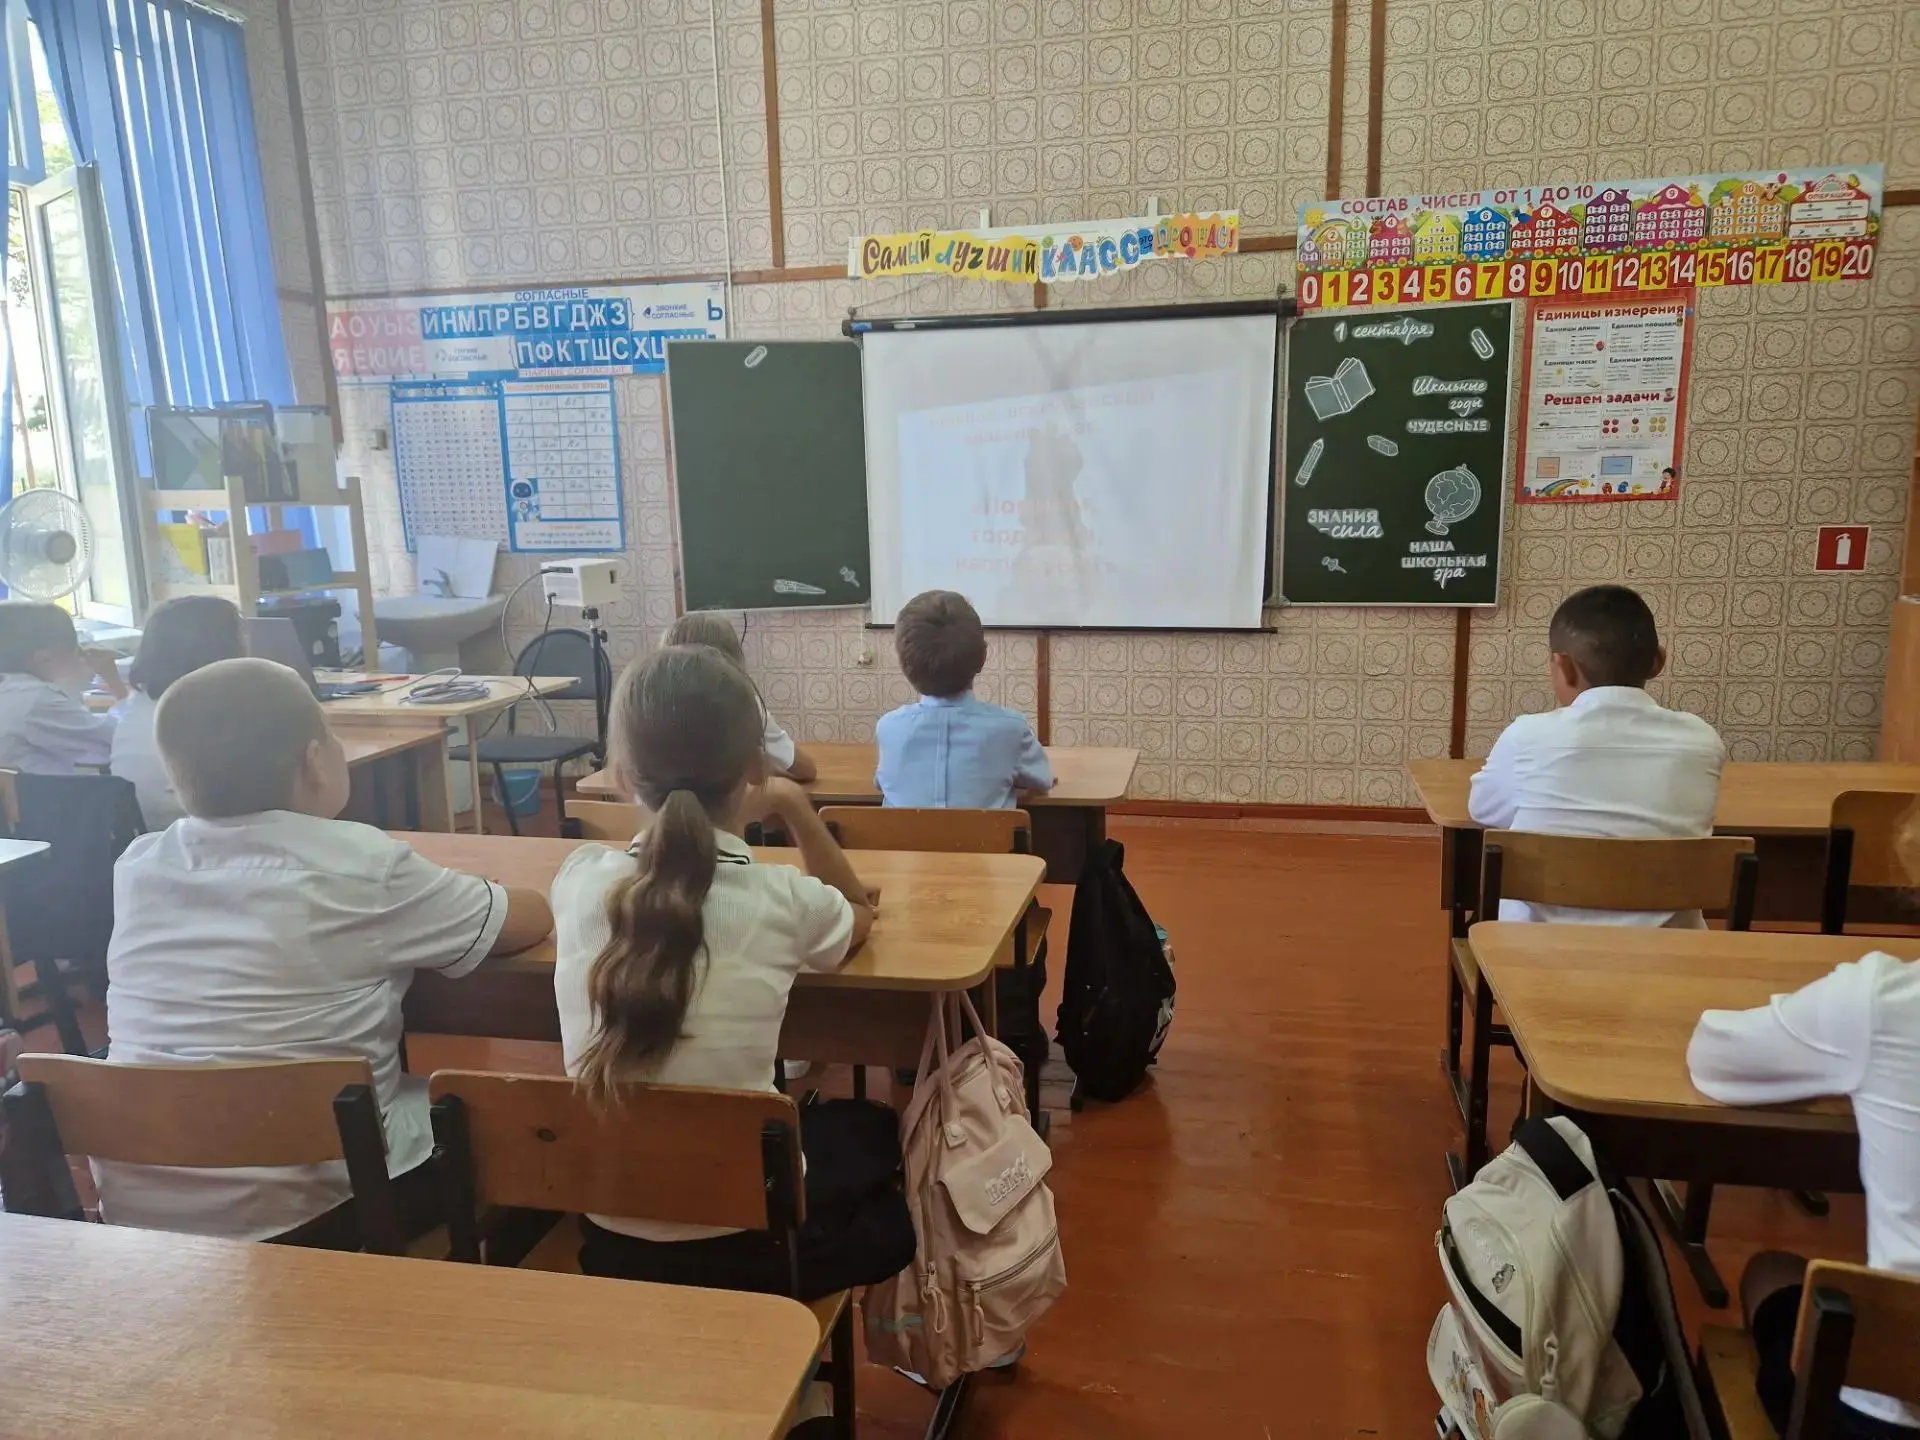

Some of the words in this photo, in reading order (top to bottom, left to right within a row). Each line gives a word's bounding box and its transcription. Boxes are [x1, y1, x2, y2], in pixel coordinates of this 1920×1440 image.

[1340, 199, 1408, 214] СОСТАВ
[1421, 193, 1480, 208] ЧИСЕЛ
[1494, 190, 1518, 204] ОТ
[1524, 190, 1530, 202] 1
[1540, 187, 1570, 204] ДО
[1574, 186, 1593, 199] 10
[863, 233, 931, 274] Самый
[1042, 233, 1139, 278] КЛАСС
[1328, 276, 1338, 303] 1
[1352, 274, 1369, 300] 2
[1378, 272, 1394, 300] 3
[1404, 270, 1420, 298] 4
[1430, 270, 1446, 297] 5
[1455, 268, 1472, 296] 6
[1482, 266, 1500, 294] 7
[1509, 264, 1525, 292] 8
[1535, 263, 1552, 292] 9
[1559, 261, 1583, 290] 10
[1586, 260, 1609, 286] 11
[1613, 258, 1639, 286] 12
[1641, 256, 1667, 284] 13
[1670, 254, 1696, 282] 14
[1699, 252, 1724, 282] 15
[1728, 251, 1753, 280] 16
[1756, 250, 1782, 279] 17
[1785, 249, 1810, 277] 18
[1815, 246, 1840, 276] 19
[1841, 244, 1872, 275] 20
[515, 288, 589, 302] СОГЛАСНЫЕ
[1536, 308, 1600, 322] Единицы
[1605, 305, 1684, 318] измерения
[1335, 322, 1345, 339] 1
[1413, 378, 1488, 394] Школьные
[1450, 397, 1482, 416] годы
[1544, 394, 1601, 406] Решаем
[1606, 392, 1660, 404] задачи
[1407, 420, 1488, 433] ЧУДЕСНЫЕ
[1308, 509, 1379, 523] ЗНАНИЯ
[1410, 540, 1455, 553] НАША
[1402, 555, 1487, 568] ШКОЛЬНАЯ
[1433, 567, 1466, 589] эра
